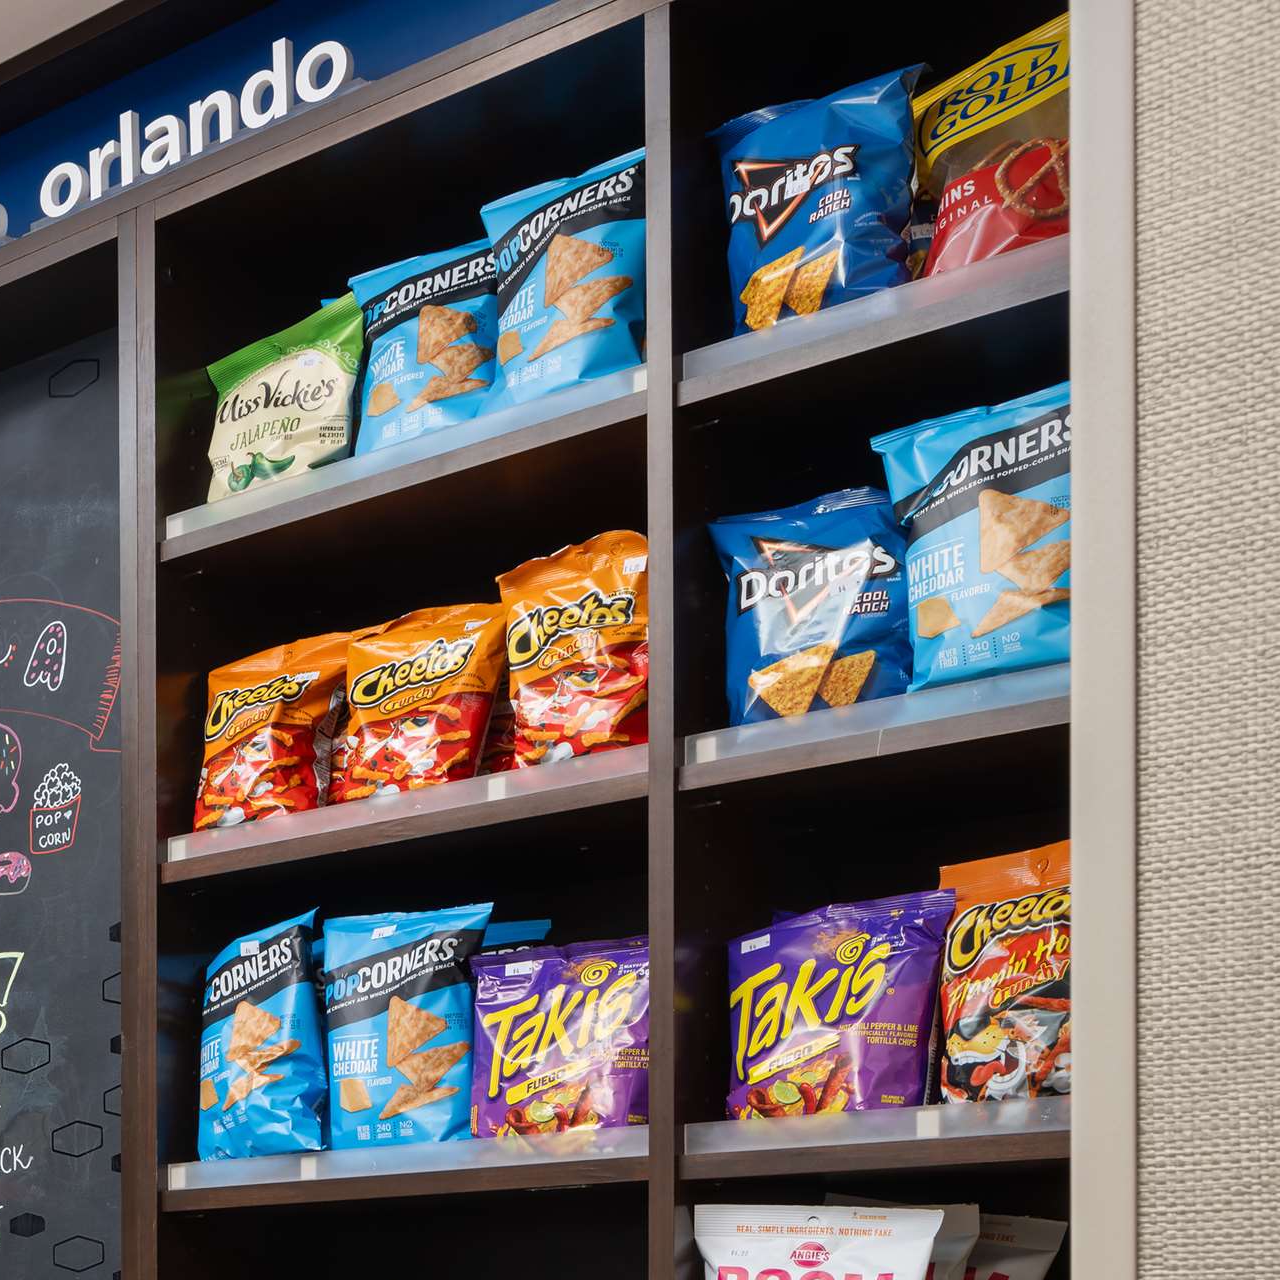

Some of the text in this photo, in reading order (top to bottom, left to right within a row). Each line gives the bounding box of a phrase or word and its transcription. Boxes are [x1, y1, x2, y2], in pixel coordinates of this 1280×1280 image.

[39, 36, 353, 218] orlando
[818, 188, 850, 207] COOL
[809, 198, 851, 224] RANCH
[262, 370, 336, 413] Vickie's
[230, 416, 301, 452] JALAPEÑO
[909, 543, 964, 582] WHITE
[741, 545, 896, 609] Doritos
[855, 590, 889, 603] COOL
[951, 583, 990, 602] FLAVORED
[843, 600, 889, 615] RANCH
[507, 591, 635, 670] Cheetos
[968, 641, 989, 654] 240
[349, 638, 476, 708] Cheetos
[225, 705, 273, 740] Crunchy
[35, 812, 63, 829] POP
[39, 828, 72, 849] CORN
[870, 1023, 919, 1033] PEPPER LIME
[333, 1039, 378, 1062] WHITE
[866, 1036, 918, 1048] TORTILLA CHIPS
[333, 1058, 378, 1076] CHEDDAR
[758, 1226, 872, 1236] SIMPLE NOTHING
[789, 1250, 831, 1262] ANGIE'S
